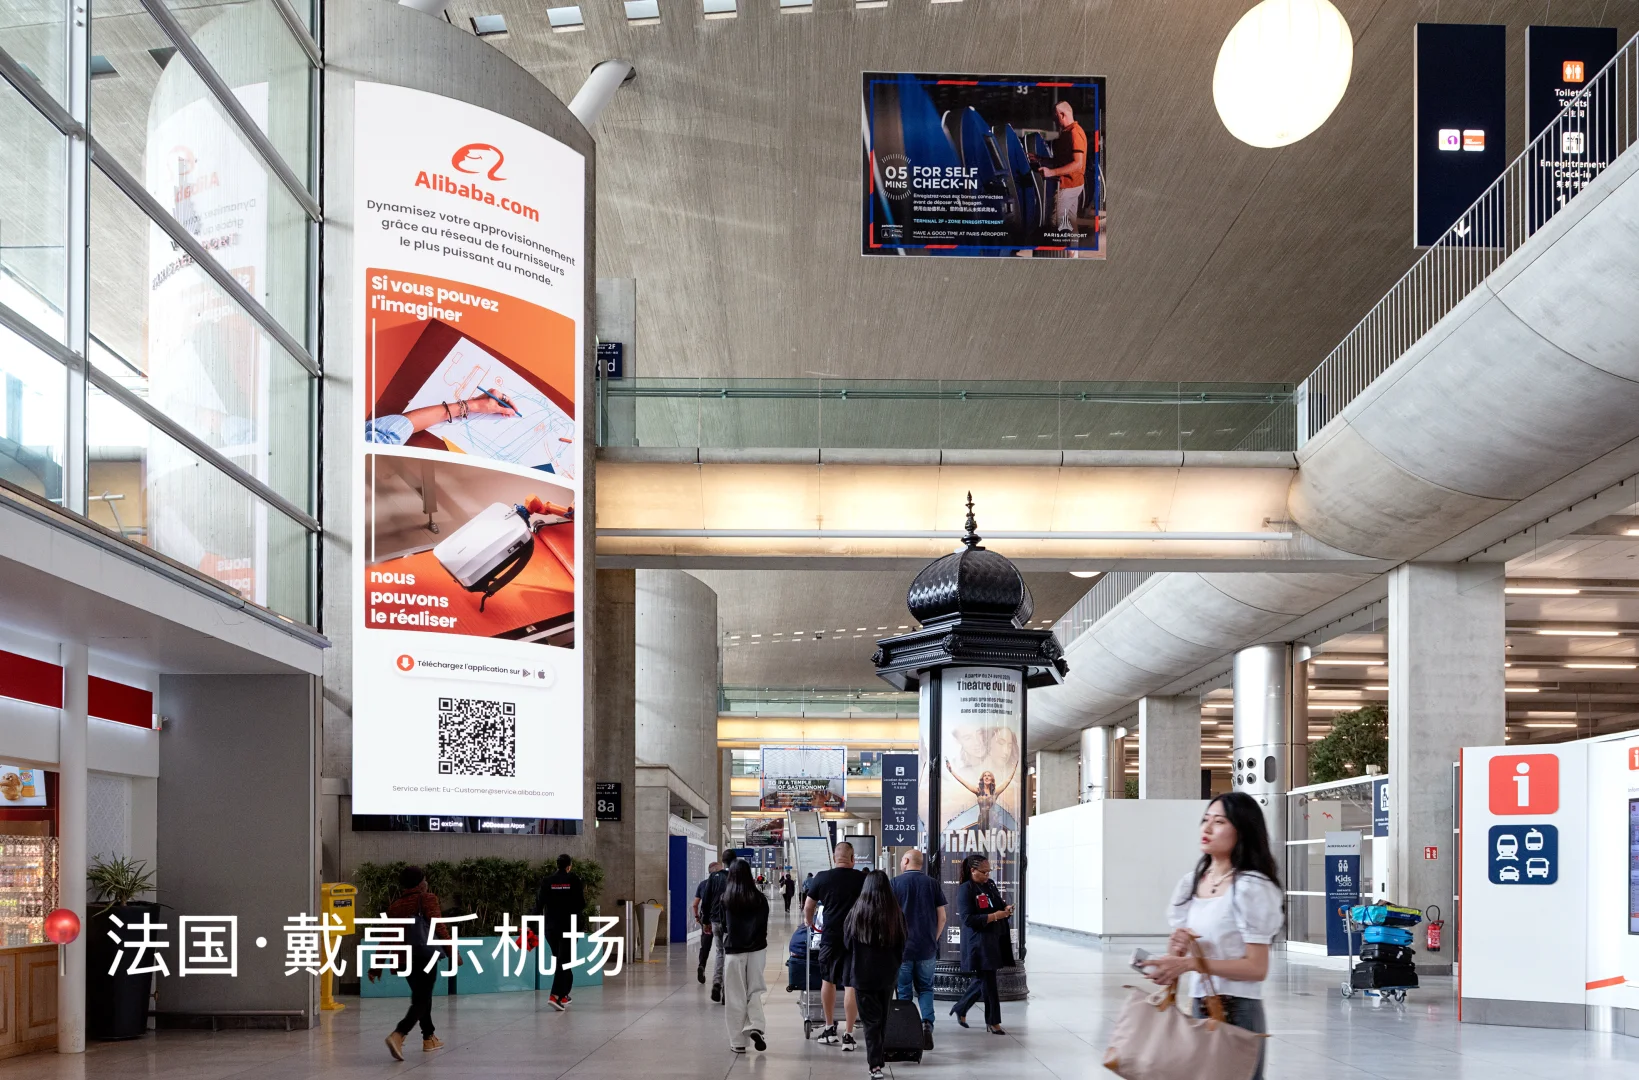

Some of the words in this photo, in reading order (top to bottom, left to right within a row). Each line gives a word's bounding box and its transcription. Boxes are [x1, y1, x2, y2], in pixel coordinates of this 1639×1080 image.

[886, 166, 907, 179] 05
[914, 167, 941, 177] FOR
[946, 167, 978, 178] SELF
[913, 179, 978, 189] CHECK-IN
[415, 171, 539, 222] Alibaba.com
[367, 200, 436, 219] Dynamisez
[439, 213, 470, 226] votre
[473, 220, 575, 266] approvisionnement
[382, 218, 418, 231] grâce
[422, 226, 437, 236] au
[441, 229, 481, 246] réseau
[485, 237, 498, 250] de
[502, 244, 564, 276] fournisseurs
[400, 237, 410, 246] le
[414, 238, 440, 252] plus
[443, 246, 494, 265] puissant
[497, 259, 511, 271] au
[515, 265, 553, 287] monde.
[372, 276, 387, 290] Si
[391, 280, 433, 297] vous
[438, 288, 498, 312] pouvez
[372, 296, 462, 322] l'imaginer
[371, 570, 415, 585] nous
[371, 592, 448, 608] pouvons
[371, 609, 386, 623] le
[390, 609, 457, 628] réaliser
[418, 660, 463, 670] Téléchargez
[465, 663, 508, 674] l'application
[993, 681, 1000, 691] du
[598, 800, 614, 812] 8a
